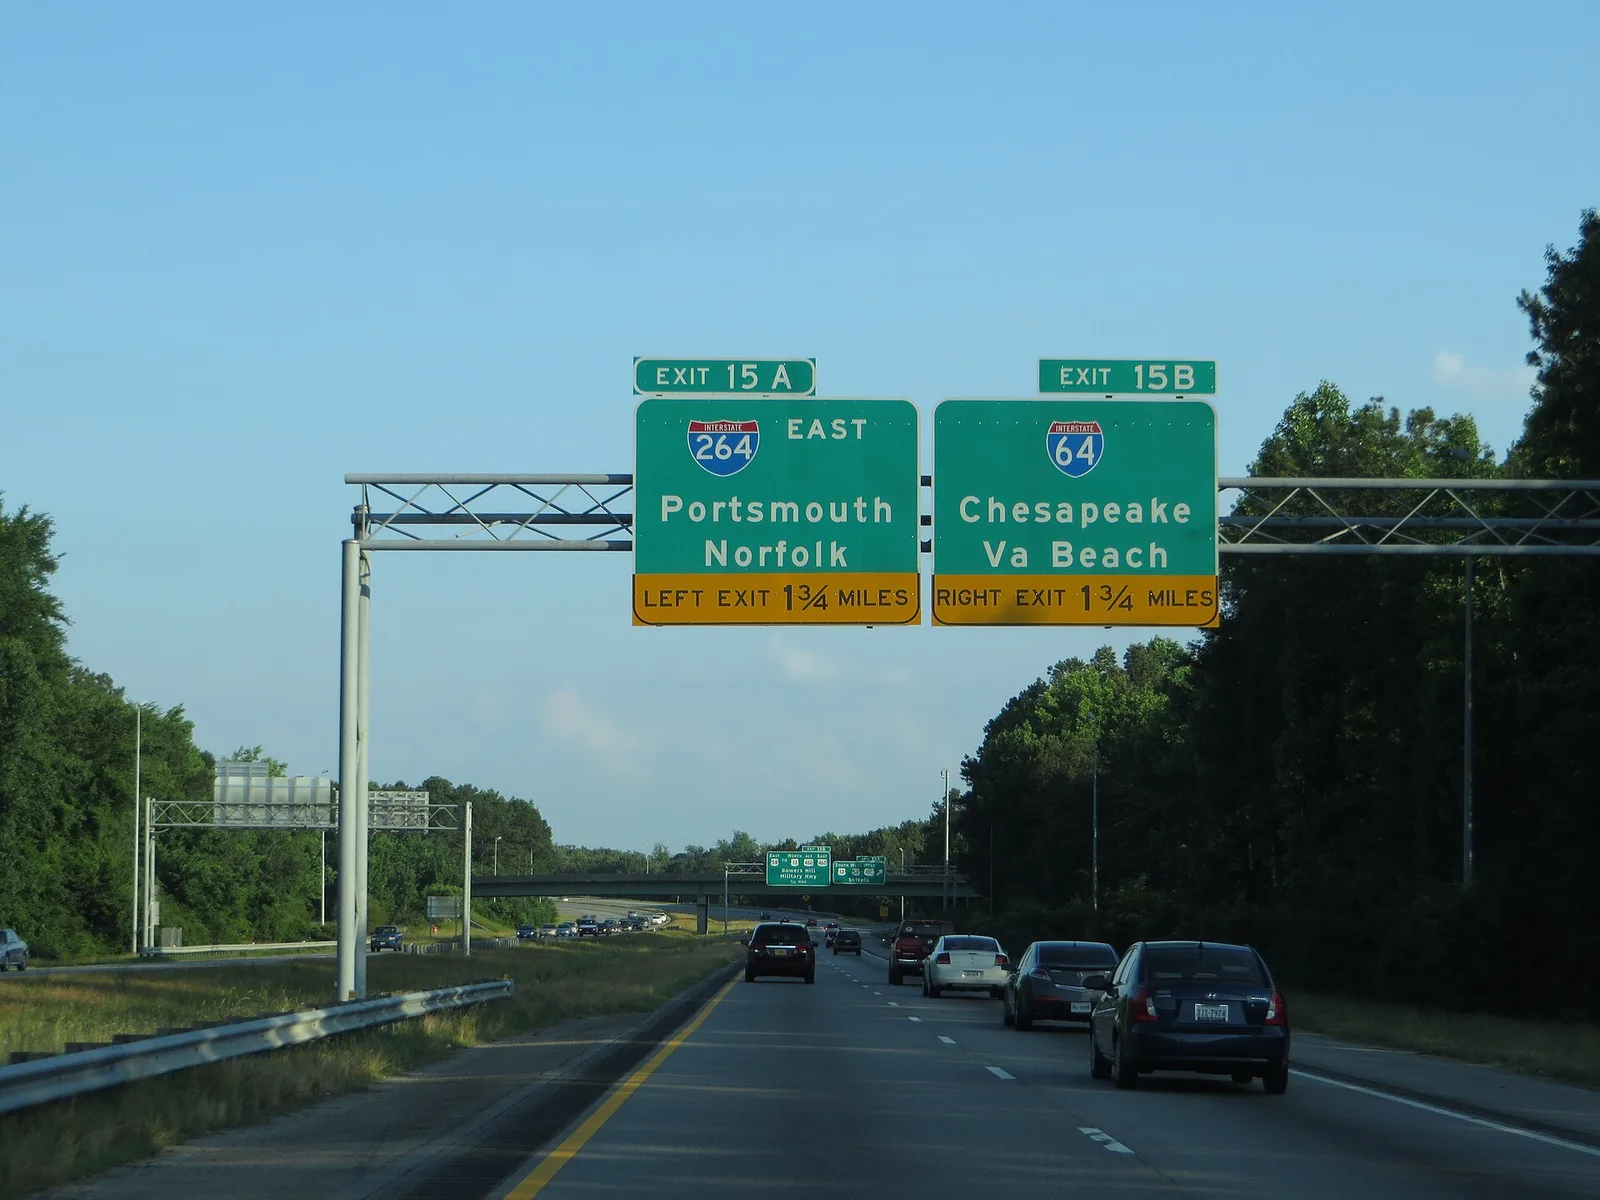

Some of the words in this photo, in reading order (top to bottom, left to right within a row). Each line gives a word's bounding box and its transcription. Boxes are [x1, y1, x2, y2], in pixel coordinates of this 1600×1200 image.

[656, 367, 709, 384] EXIT
[727, 364, 758, 389] 15
[772, 364, 792, 389] A
[1060, 368, 1111, 385] EXIT
[1135, 364, 1195, 390] 15B
[704, 423, 742, 432] INTERSTATE
[788, 419, 867, 439] EAST
[1056, 425, 1094, 433] INTERSTATE
[696, 434, 752, 460] 264
[1055, 436, 1094, 465] 64
[661, 495, 892, 523] Portsmouth
[960, 496, 1190, 528] Chesapeake
[705, 540, 847, 567] Norfolk
[983, 541, 1028, 567] Va
[1052, 541, 1168, 568] Beach
[645, 590, 703, 607] LEFT
[718, 590, 769, 607] EXIT
[838, 589, 908, 606] MILES
[937, 589, 1001, 606] RIGHT
[1017, 590, 1066, 606] EXIT
[1149, 590, 1213, 606] MILES
